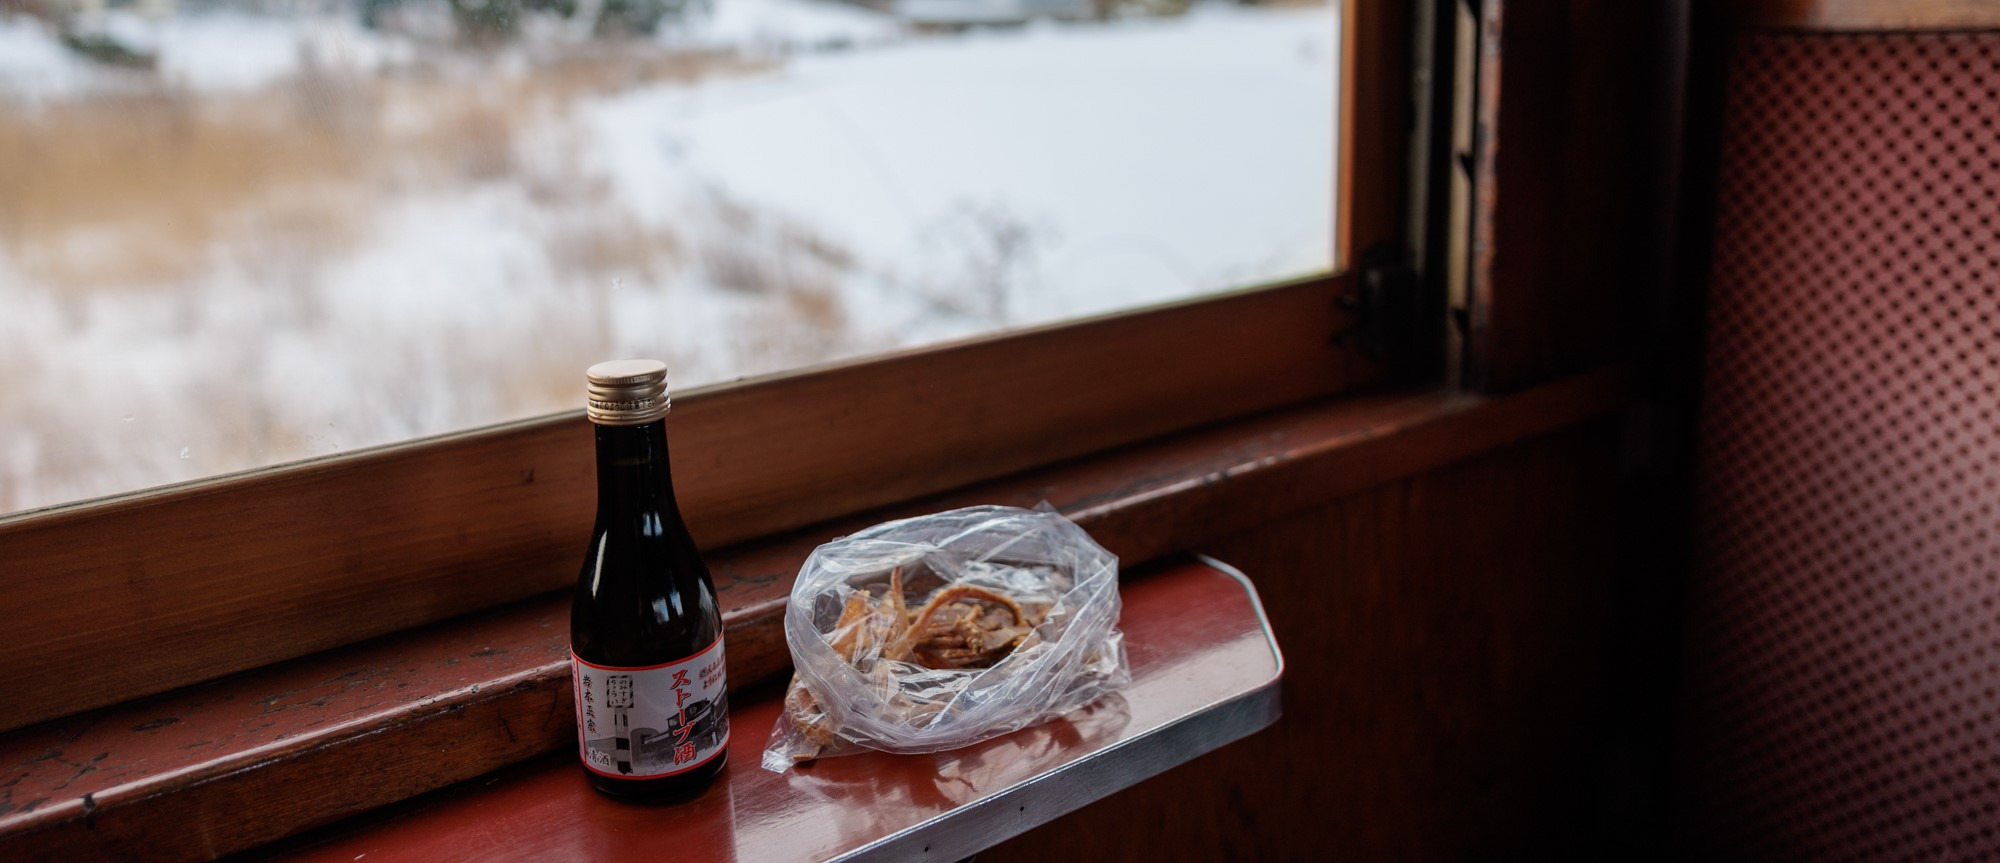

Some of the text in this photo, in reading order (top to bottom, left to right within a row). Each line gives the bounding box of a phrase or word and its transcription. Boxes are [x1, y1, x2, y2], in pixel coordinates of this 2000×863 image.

[670, 669, 697, 765] ストーブ酒
[588, 747, 610, 767] 清酒
